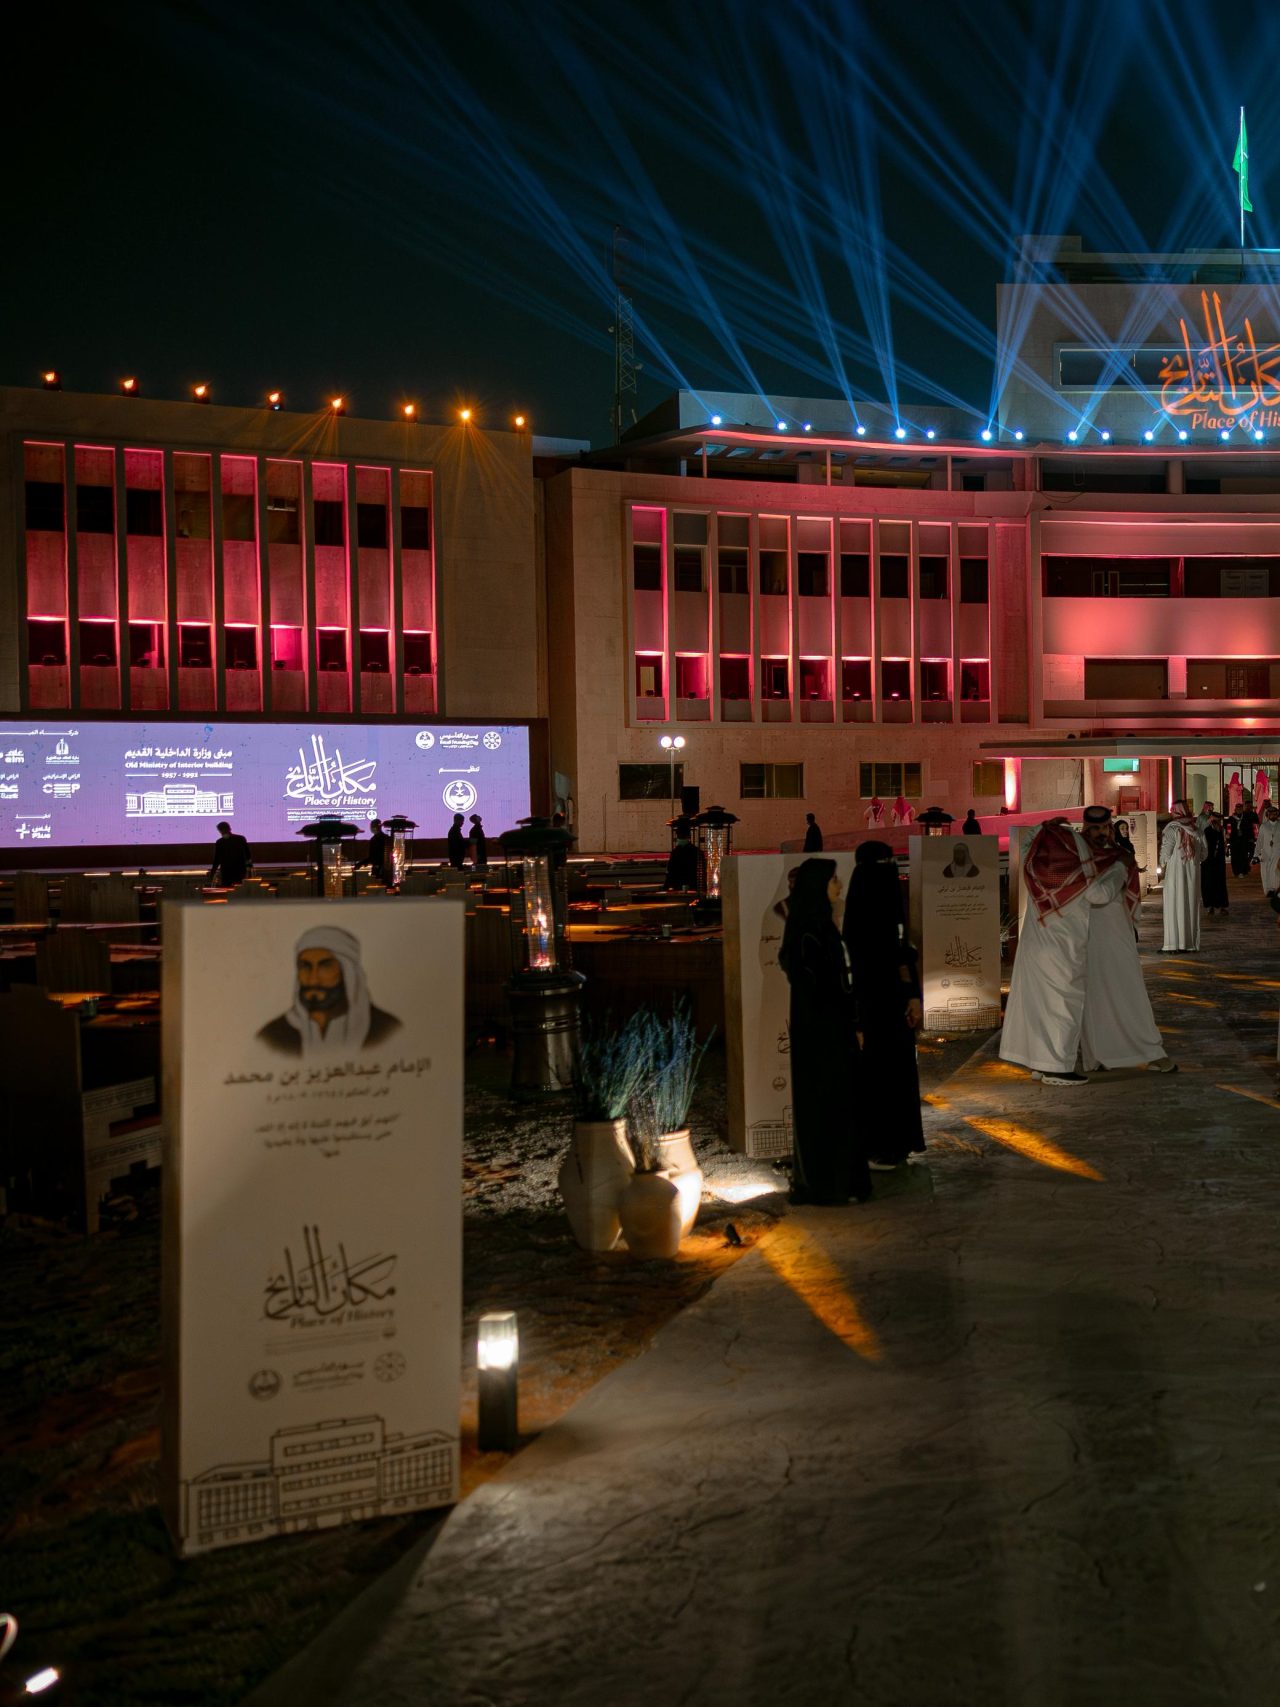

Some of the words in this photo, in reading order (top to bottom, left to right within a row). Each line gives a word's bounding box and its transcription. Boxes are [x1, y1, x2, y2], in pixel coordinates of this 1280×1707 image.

[1192, 411, 1235, 430] Place
[1239, 410, 1258, 432] of
[139, 761, 168, 769] Ministry
[304, 796, 330, 806] Place
[331, 795, 343, 807] of
[343, 796, 377, 807] History
[387, 1057, 432, 1079] الإمام
[223, 1070, 274, 1086] محمد
[280, 1071, 299, 1086] بن
